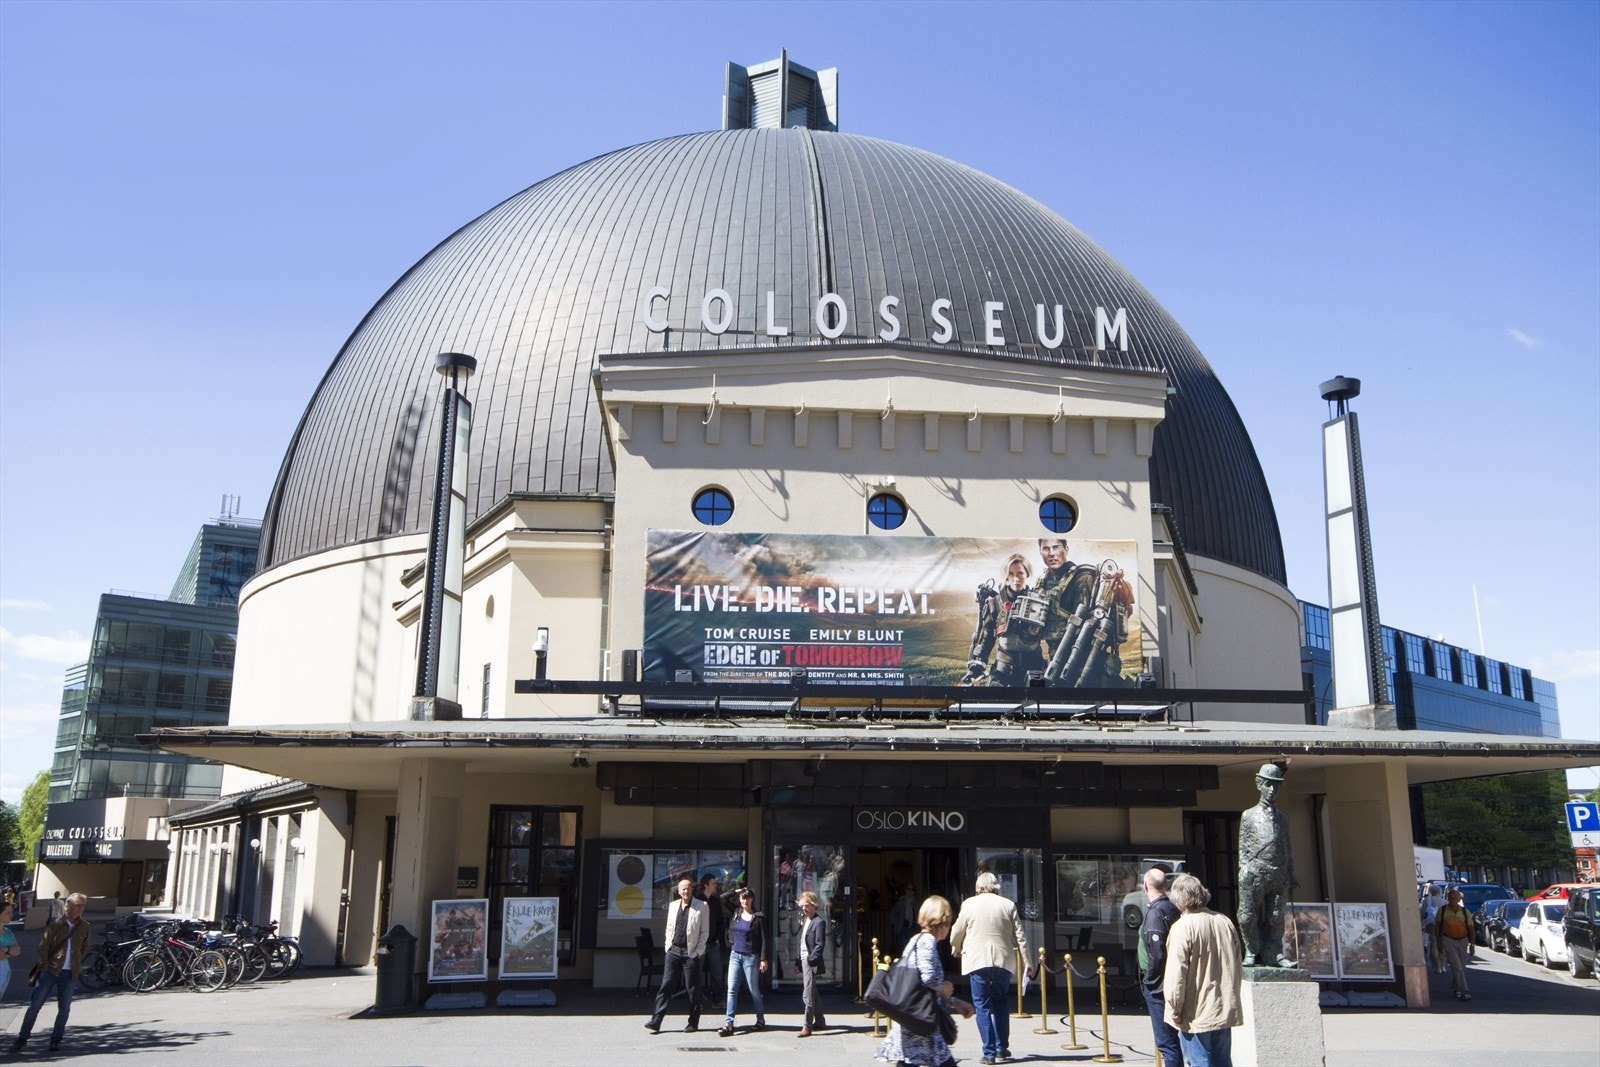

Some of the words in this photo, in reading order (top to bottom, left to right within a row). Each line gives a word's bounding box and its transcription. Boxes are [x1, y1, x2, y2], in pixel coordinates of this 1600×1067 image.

[643, 286, 1128, 352] COLOSSEUM
[674, 584, 748, 612] LIVE.
[755, 585, 810, 613] DIE.
[817, 586, 936, 615] REPEAT.
[704, 627, 734, 639] TOM
[740, 628, 791, 640] CRUISE
[809, 629, 852, 641] EMILY
[857, 629, 904, 641] BLUNT
[703, 644, 757, 665] EDGE
[760, 649, 781, 666] OF
[782, 645, 904, 667] TOMORROW
[1573, 806, 1591, 829] P
[46, 844, 74, 856] BILLETTER
[512, 905, 532, 917] KULE
[533, 905, 552, 917] KRYP
[1343, 909, 1361, 920] KULE
[1362, 909, 1380, 920] KRYP
